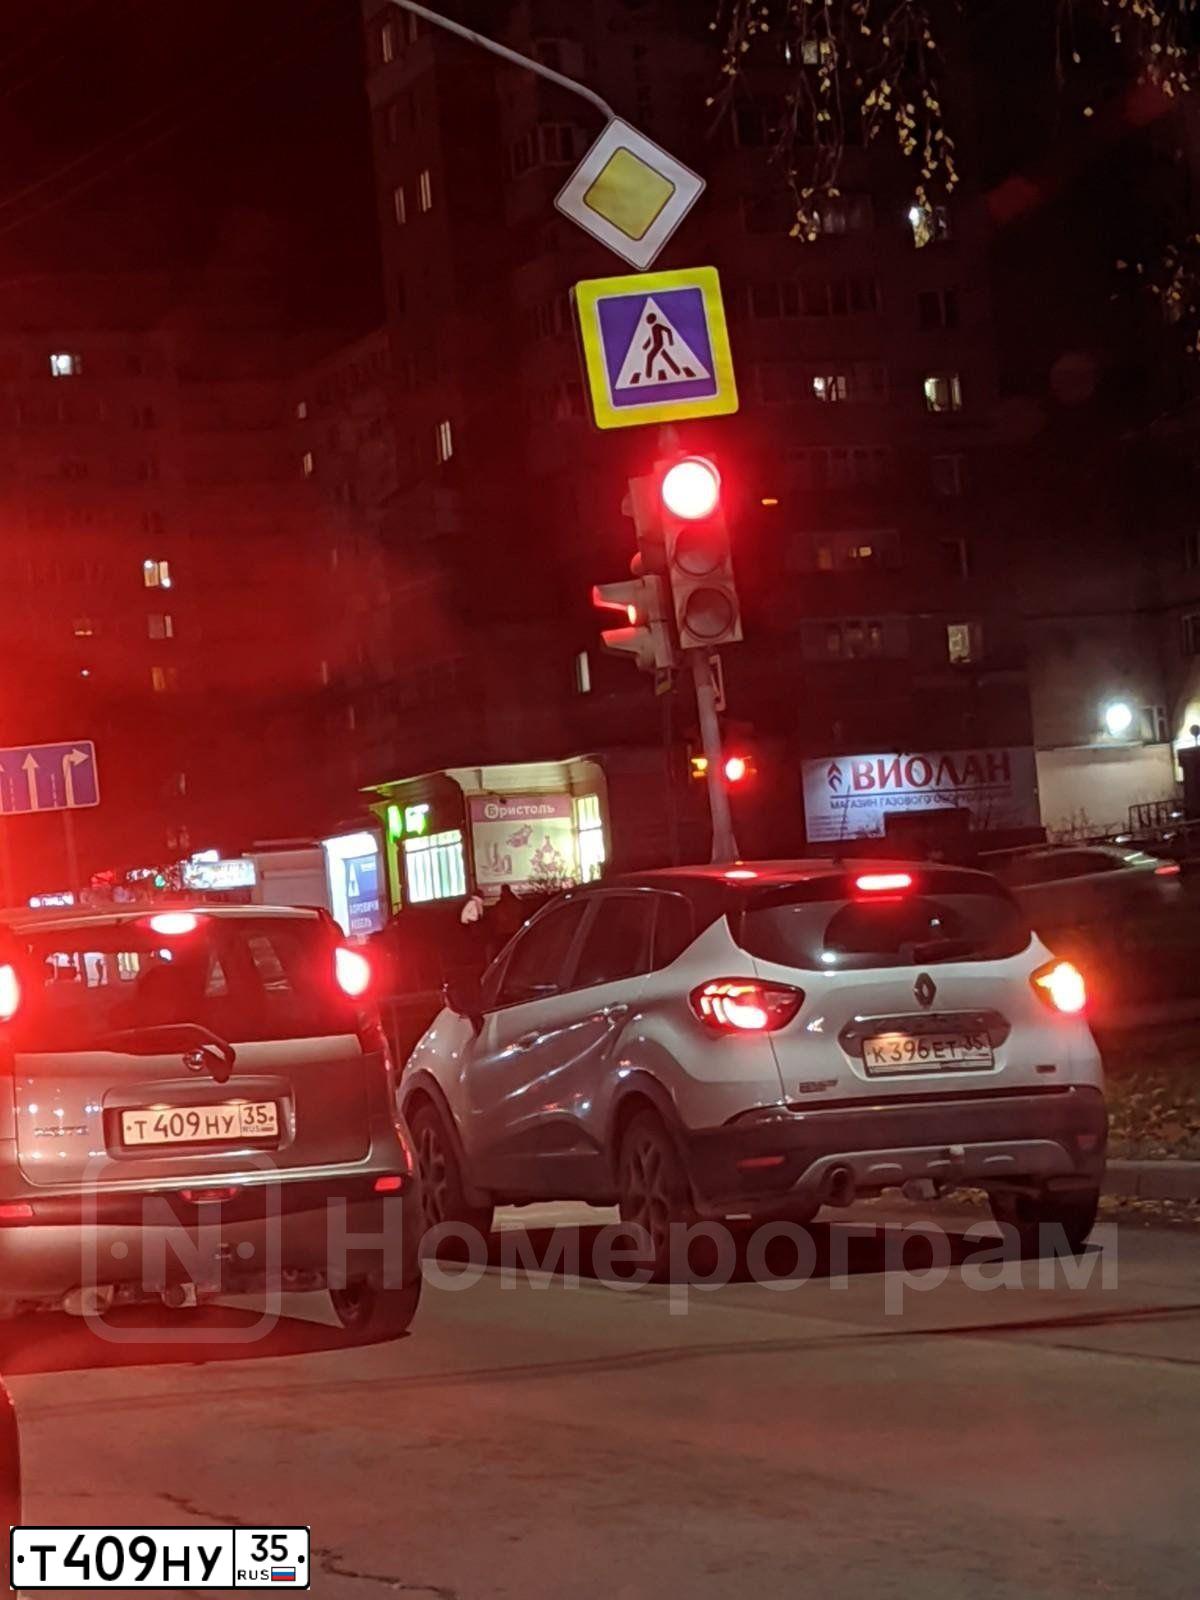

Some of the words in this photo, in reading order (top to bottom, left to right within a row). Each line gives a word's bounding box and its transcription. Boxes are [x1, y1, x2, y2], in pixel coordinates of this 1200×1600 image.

[852, 752, 1010, 791] ВИОЛАН
[484, 803, 555, 819] Бристоль
[830, 798, 878, 810] МАГАЗИН
[880, 795, 931, 808] ГАЗОВОГО
[243, 1105, 268, 1125] 35
